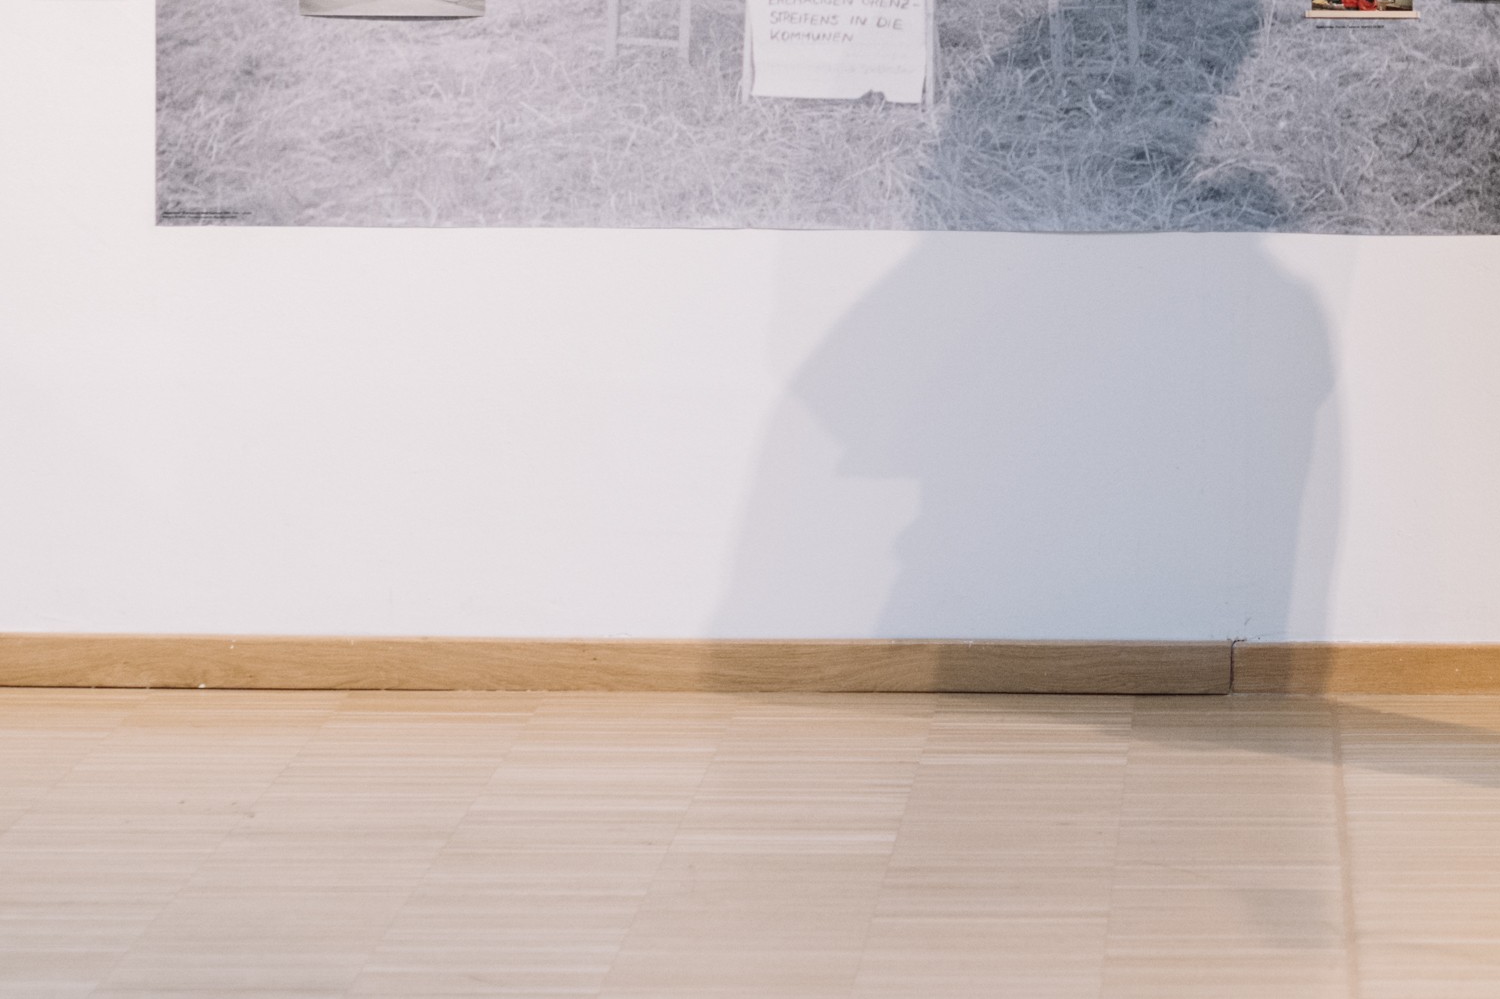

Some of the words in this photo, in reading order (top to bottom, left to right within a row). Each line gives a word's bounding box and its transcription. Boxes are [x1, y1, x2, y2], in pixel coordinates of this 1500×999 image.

[769, 10, 840, 27] STREIFENS
[850, 15, 868, 27] IN
[876, 16, 904, 31] DIE
[769, 28, 854, 43] KOMMUNEN
